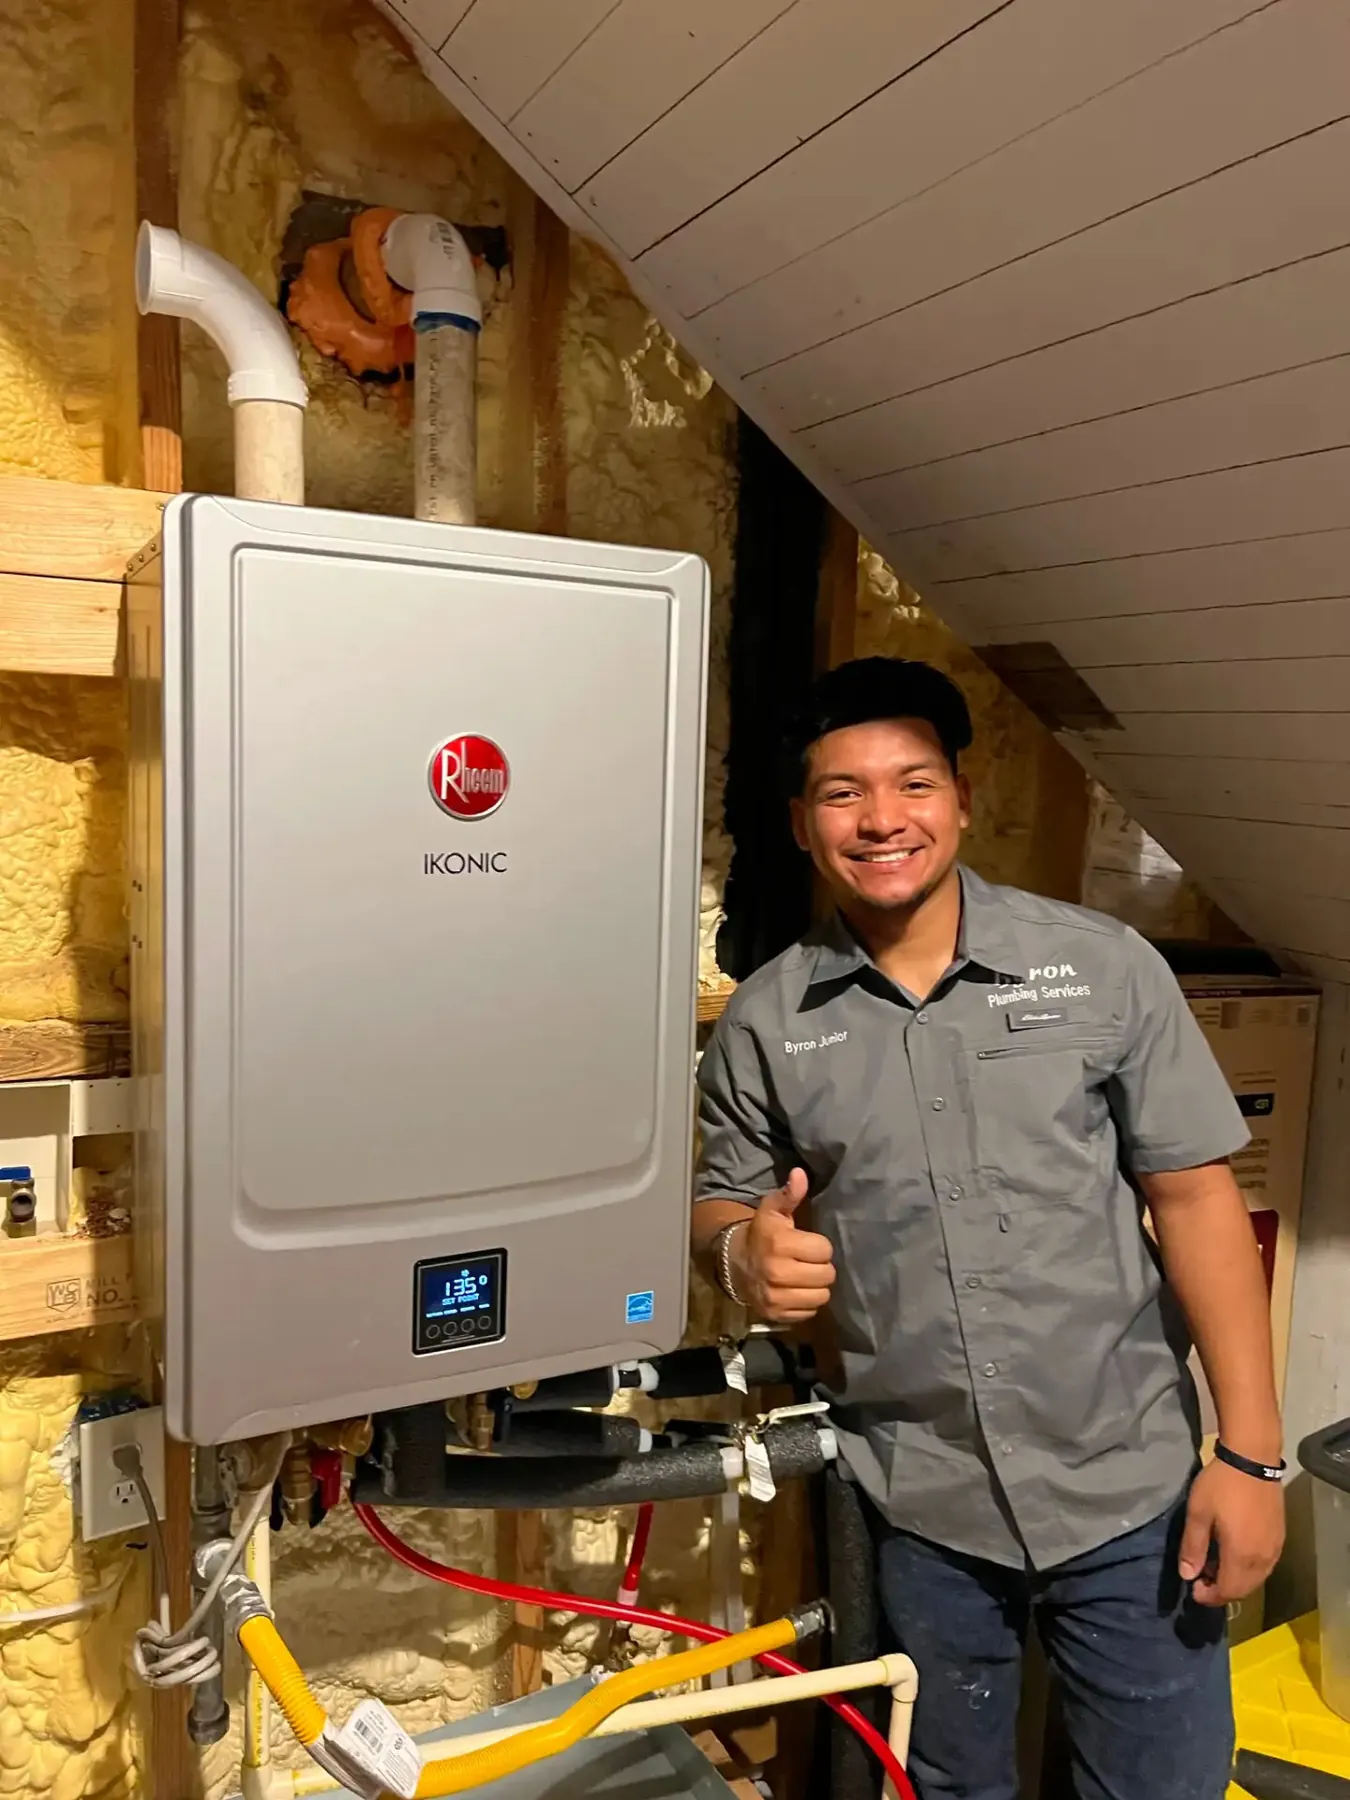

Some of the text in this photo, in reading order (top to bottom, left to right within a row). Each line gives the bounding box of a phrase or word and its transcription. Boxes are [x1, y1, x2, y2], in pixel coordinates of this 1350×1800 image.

[440, 740, 504, 804] Rheem
[424, 852, 507, 875] IKONIC
[987, 983, 1091, 1008] Plumbing Services
[784, 1031, 848, 1055] Byron Junior
